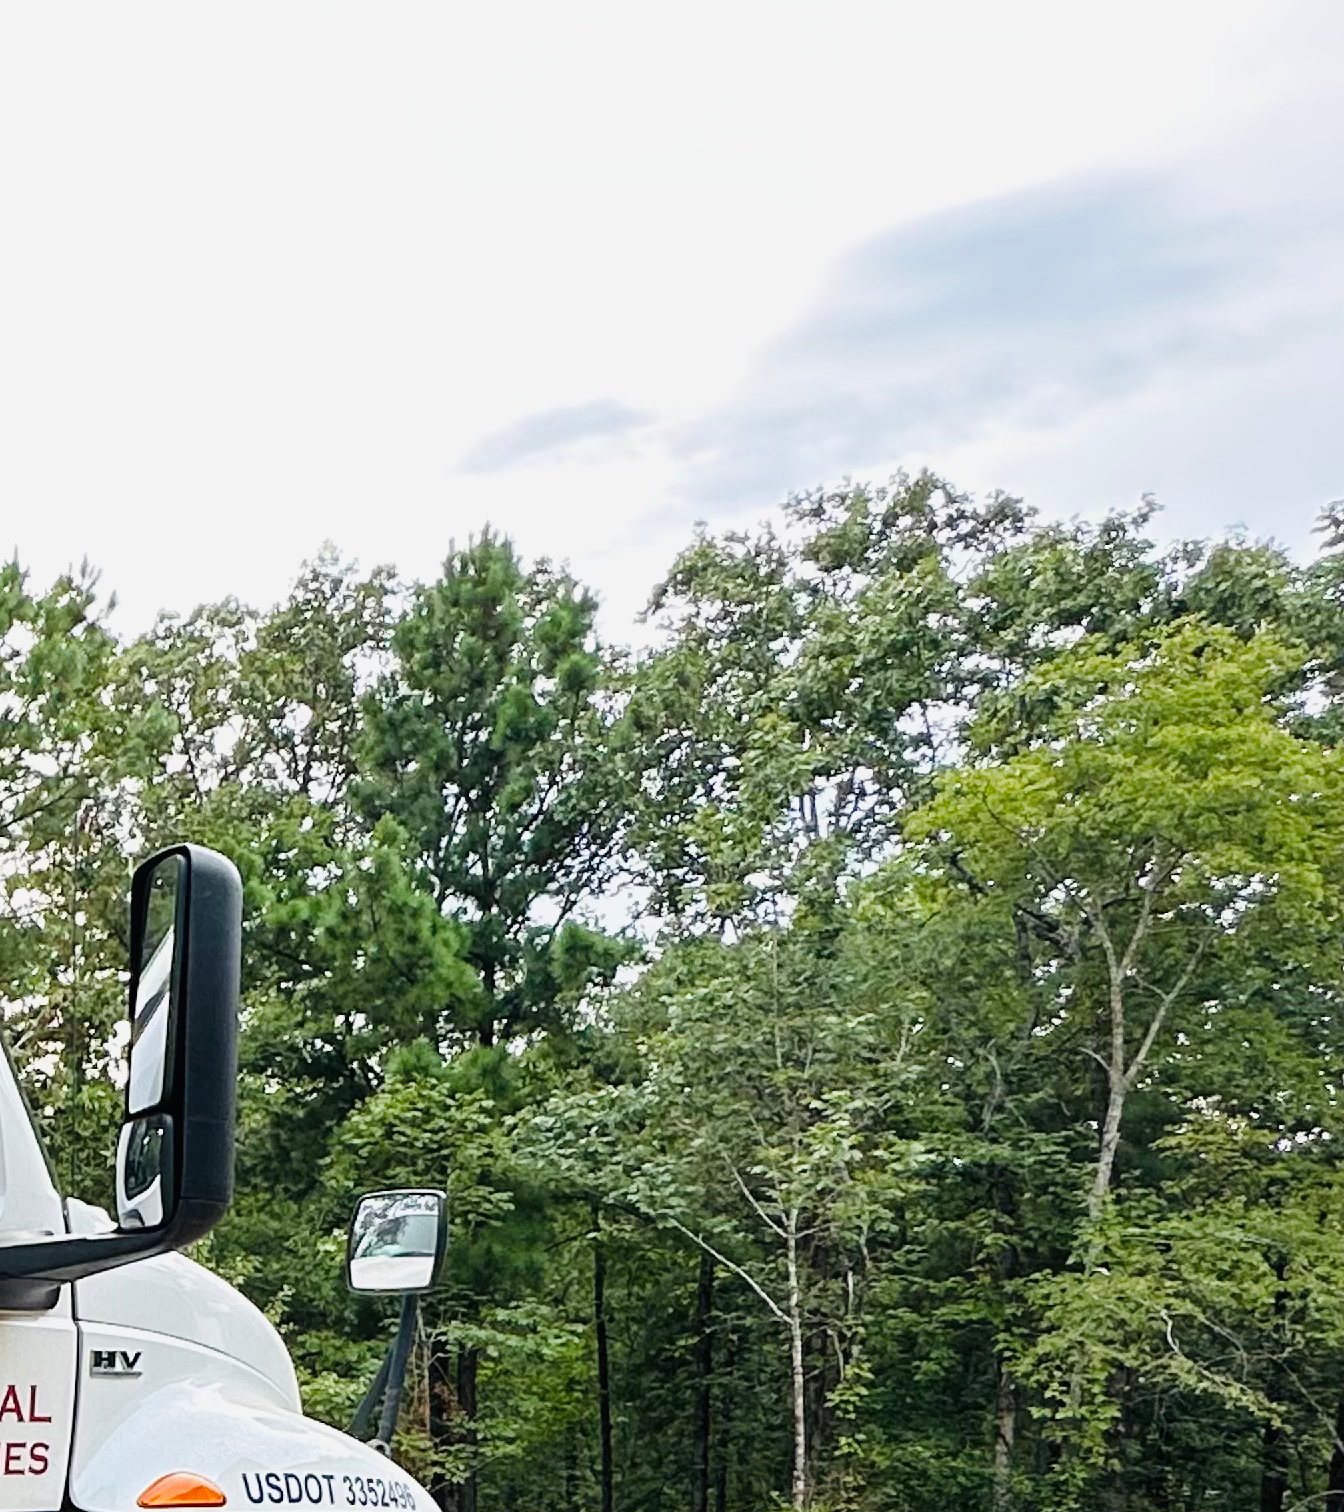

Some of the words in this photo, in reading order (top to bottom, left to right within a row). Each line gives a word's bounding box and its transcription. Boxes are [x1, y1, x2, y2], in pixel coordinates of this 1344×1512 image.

[91, 1350, 143, 1370] HV
[241, 1473, 335, 1505] USDOT
[342, 1475, 416, 1511] 3352496
